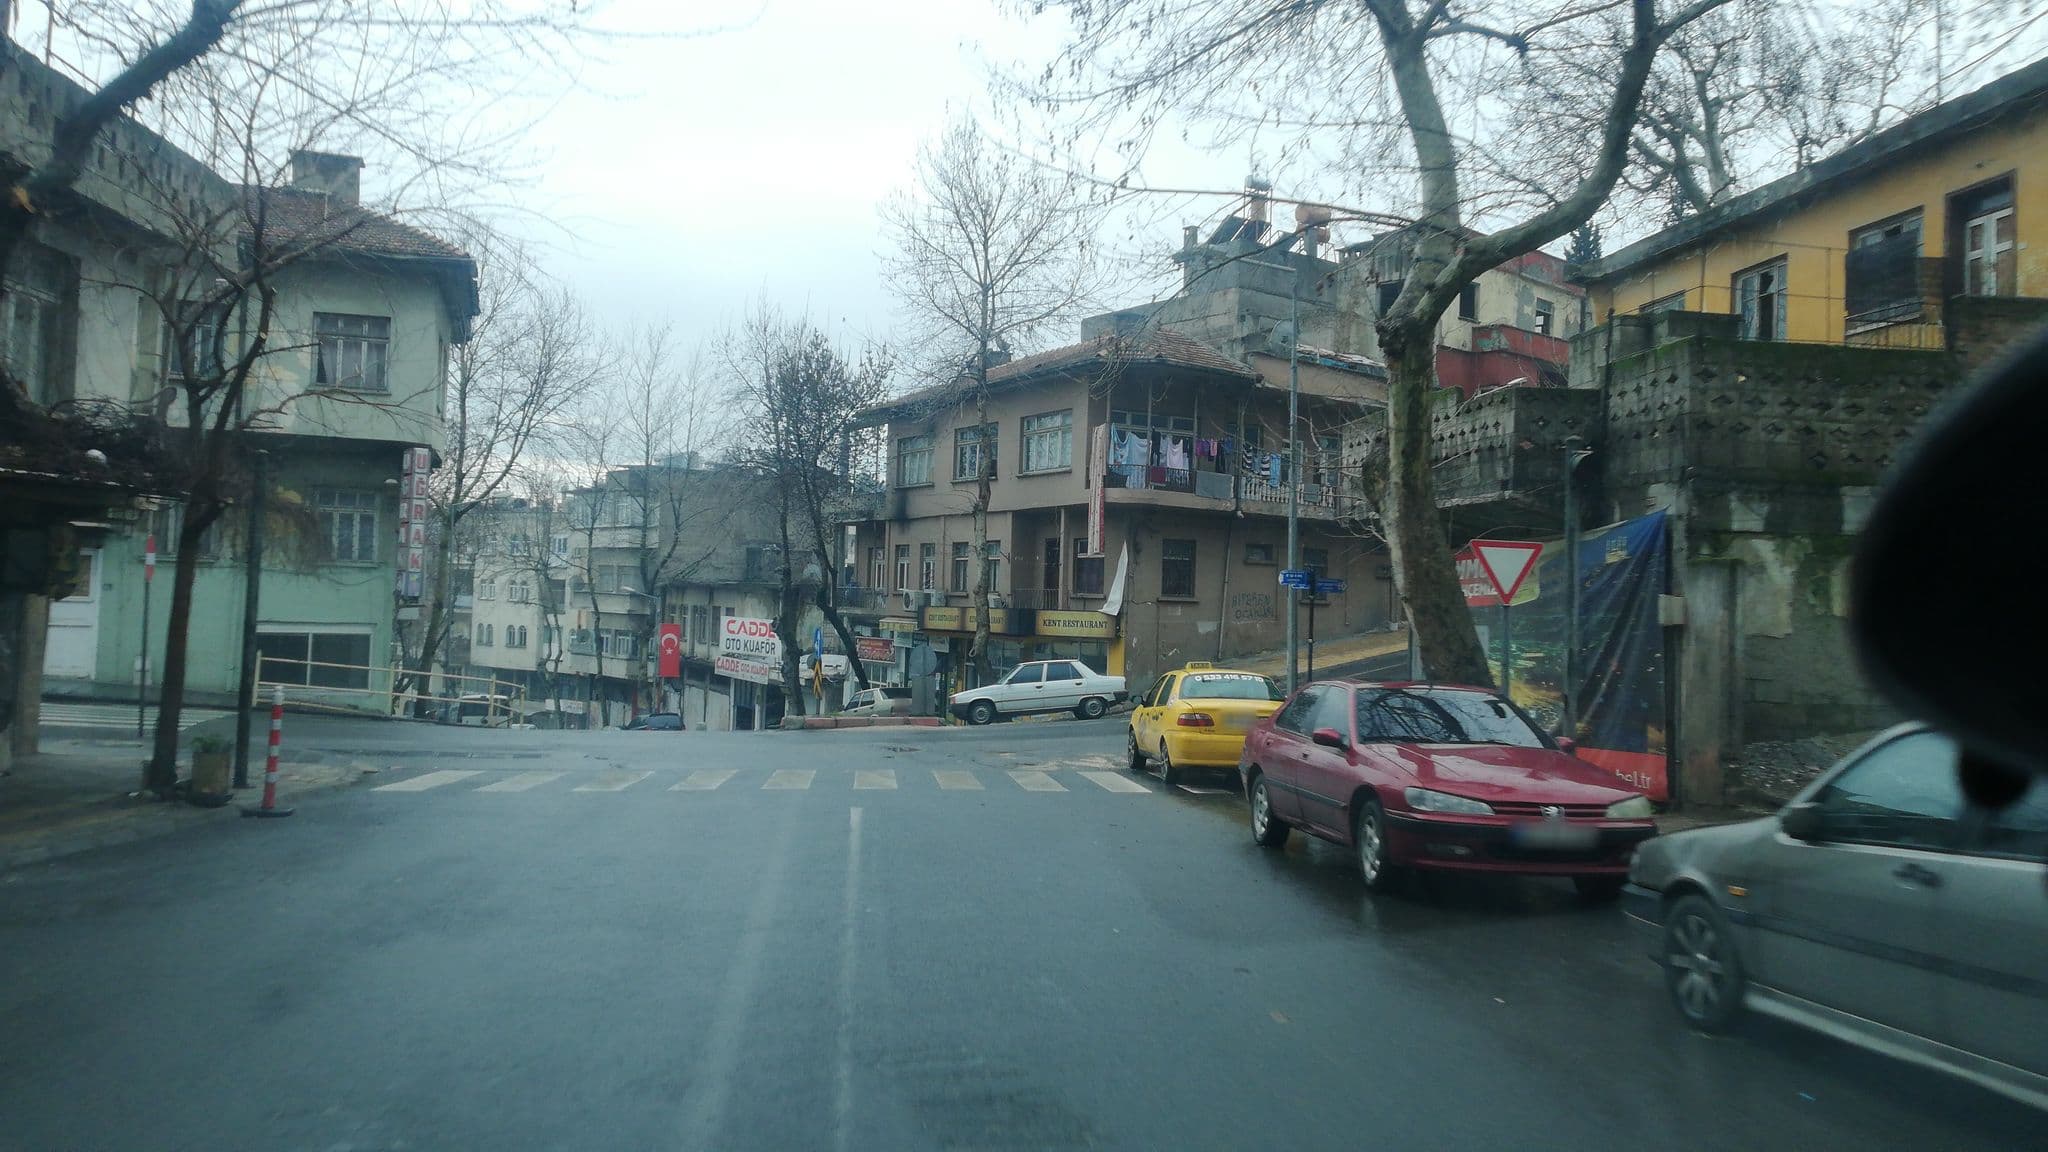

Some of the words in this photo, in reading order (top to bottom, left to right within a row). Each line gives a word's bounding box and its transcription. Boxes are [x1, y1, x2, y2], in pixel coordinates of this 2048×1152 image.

[1043, 619, 1062, 627] KENT
[1062, 619, 1108, 629] RESTAURANT
[725, 638, 741, 651] OTO
[743, 638, 776, 655] KUAFÖR
[716, 656, 740, 673] CADDE
[740, 663, 750, 673] OTO
